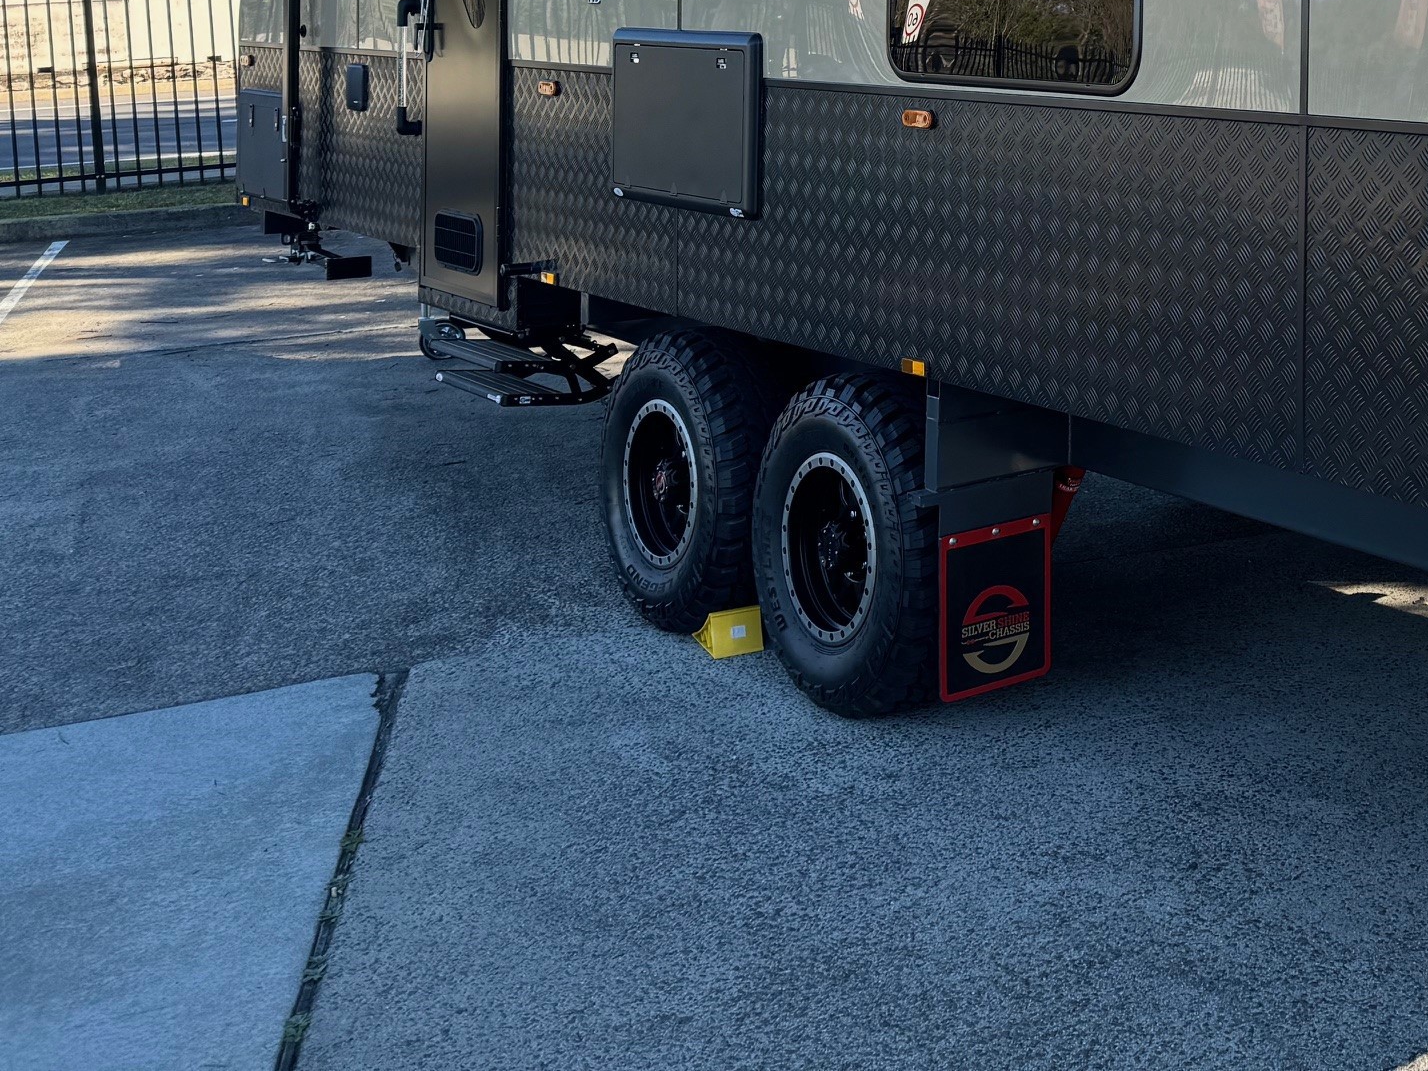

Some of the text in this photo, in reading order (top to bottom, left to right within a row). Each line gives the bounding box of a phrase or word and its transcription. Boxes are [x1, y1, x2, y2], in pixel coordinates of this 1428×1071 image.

[961, 611, 1030, 639] SILVER SHINE
[988, 621, 1030, 641] CHASSIS
